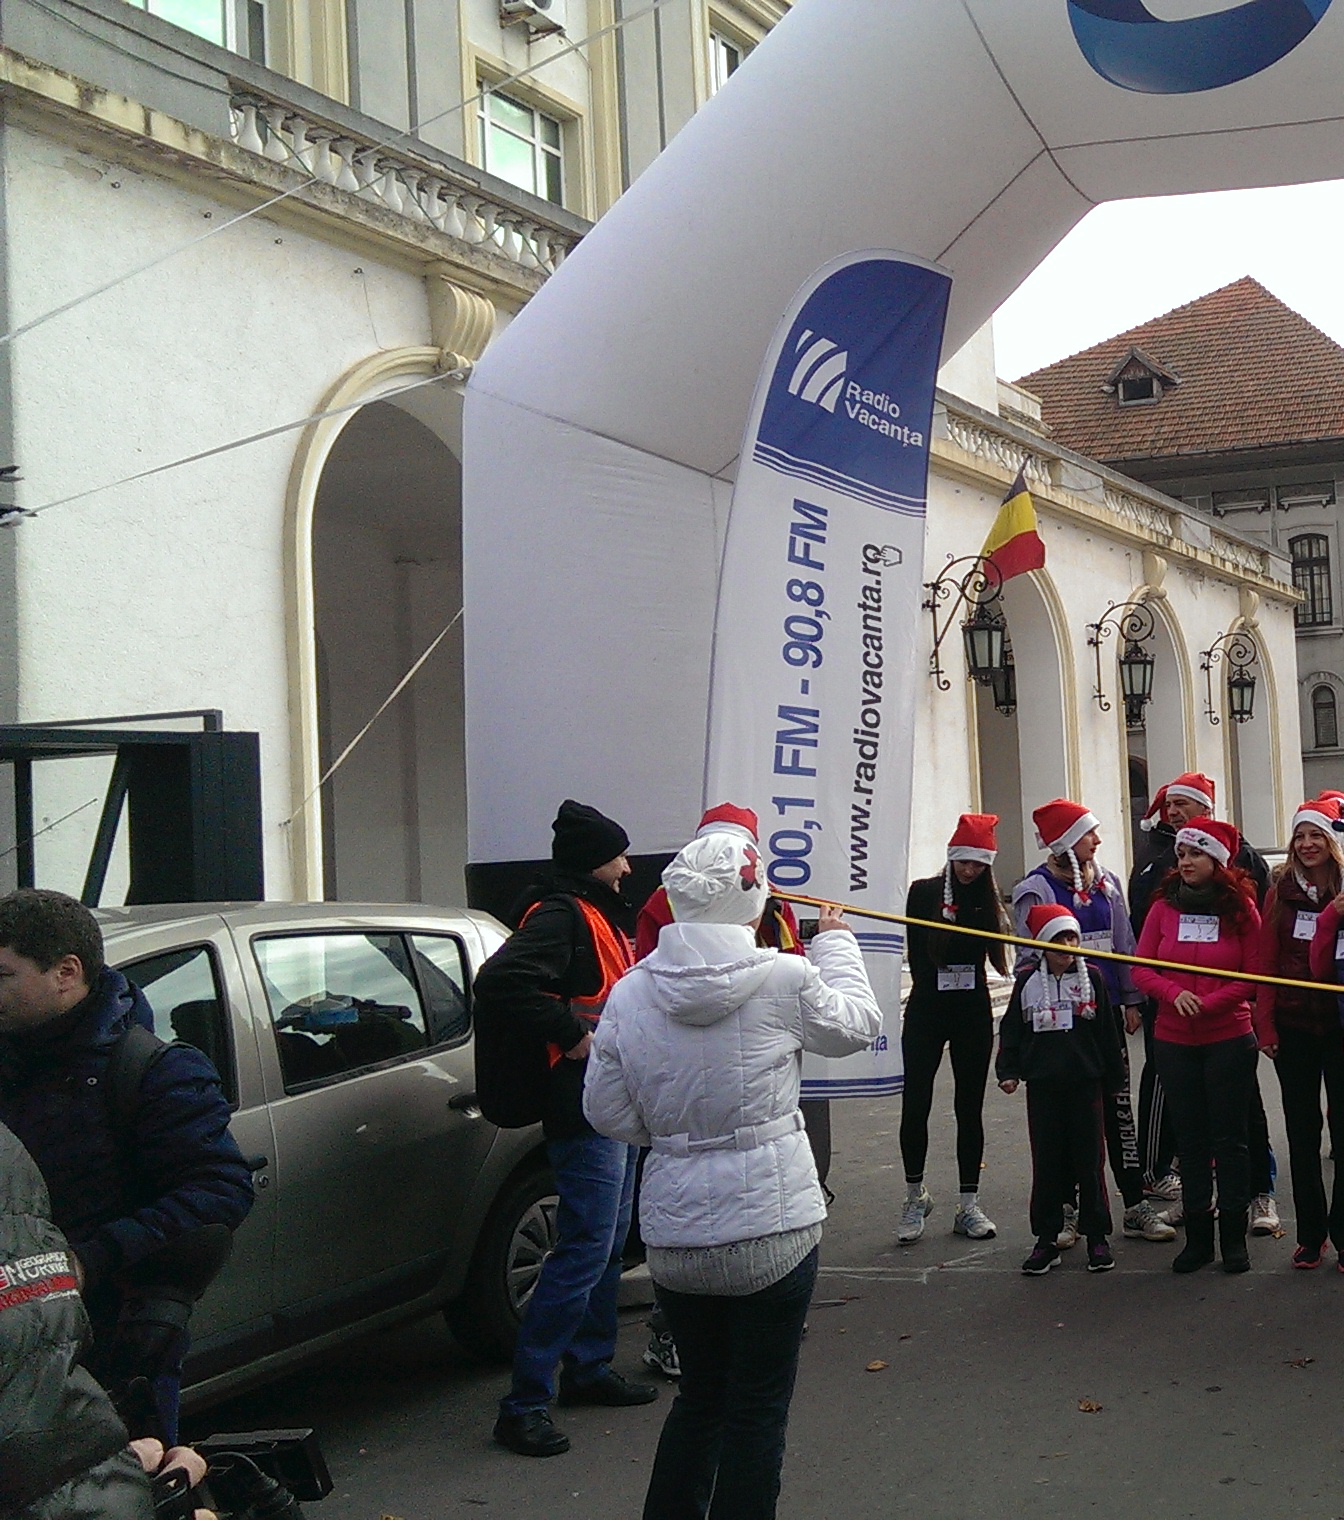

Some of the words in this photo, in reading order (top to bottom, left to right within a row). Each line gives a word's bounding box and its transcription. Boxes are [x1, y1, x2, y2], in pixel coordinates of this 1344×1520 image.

[846, 381, 900, 418] Radio
[787, 498, 828, 571] FM
[782, 578, 831, 669] 90,8
[800, 678, 809, 695] -
[850, 543, 884, 892] www.radiovacanta.ro
[773, 704, 820, 777] FM
[1119, 1121, 1140, 1169] TRACK
